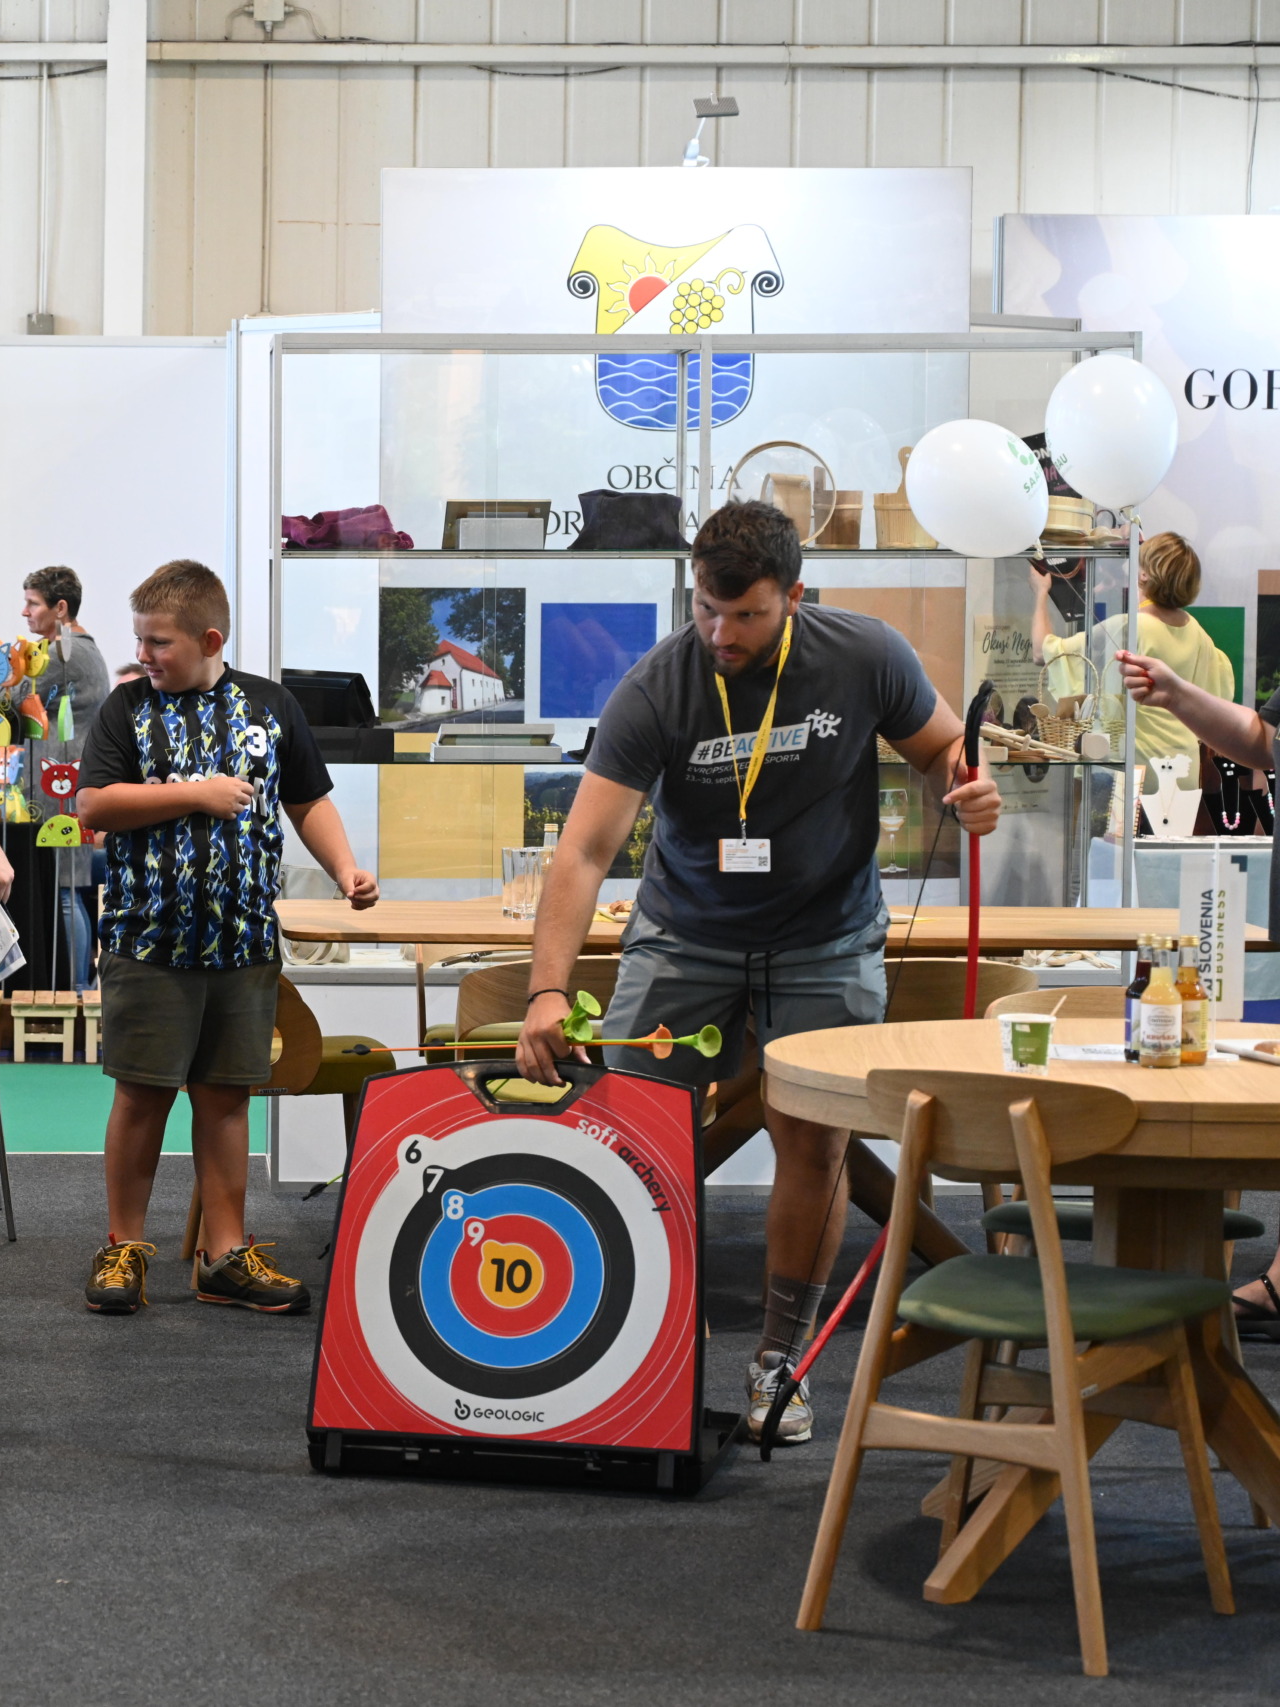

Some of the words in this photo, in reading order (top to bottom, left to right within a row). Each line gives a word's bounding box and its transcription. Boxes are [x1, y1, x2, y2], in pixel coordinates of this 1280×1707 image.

[607, 457, 743, 490] OBČNA
[245, 725, 267, 757] 3
[1198, 889, 1214, 973] SLOVENIA
[1216, 889, 1226, 974] BUSINESS
[405, 1139, 422, 1164] 6
[576, 1119, 619, 1149] soft
[618, 1146, 671, 1212] archery
[426, 1168, 445, 1194] 7
[446, 1194, 464, 1220] 8
[467, 1221, 485, 1247] 9
[490, 1258, 532, 1294] 10
